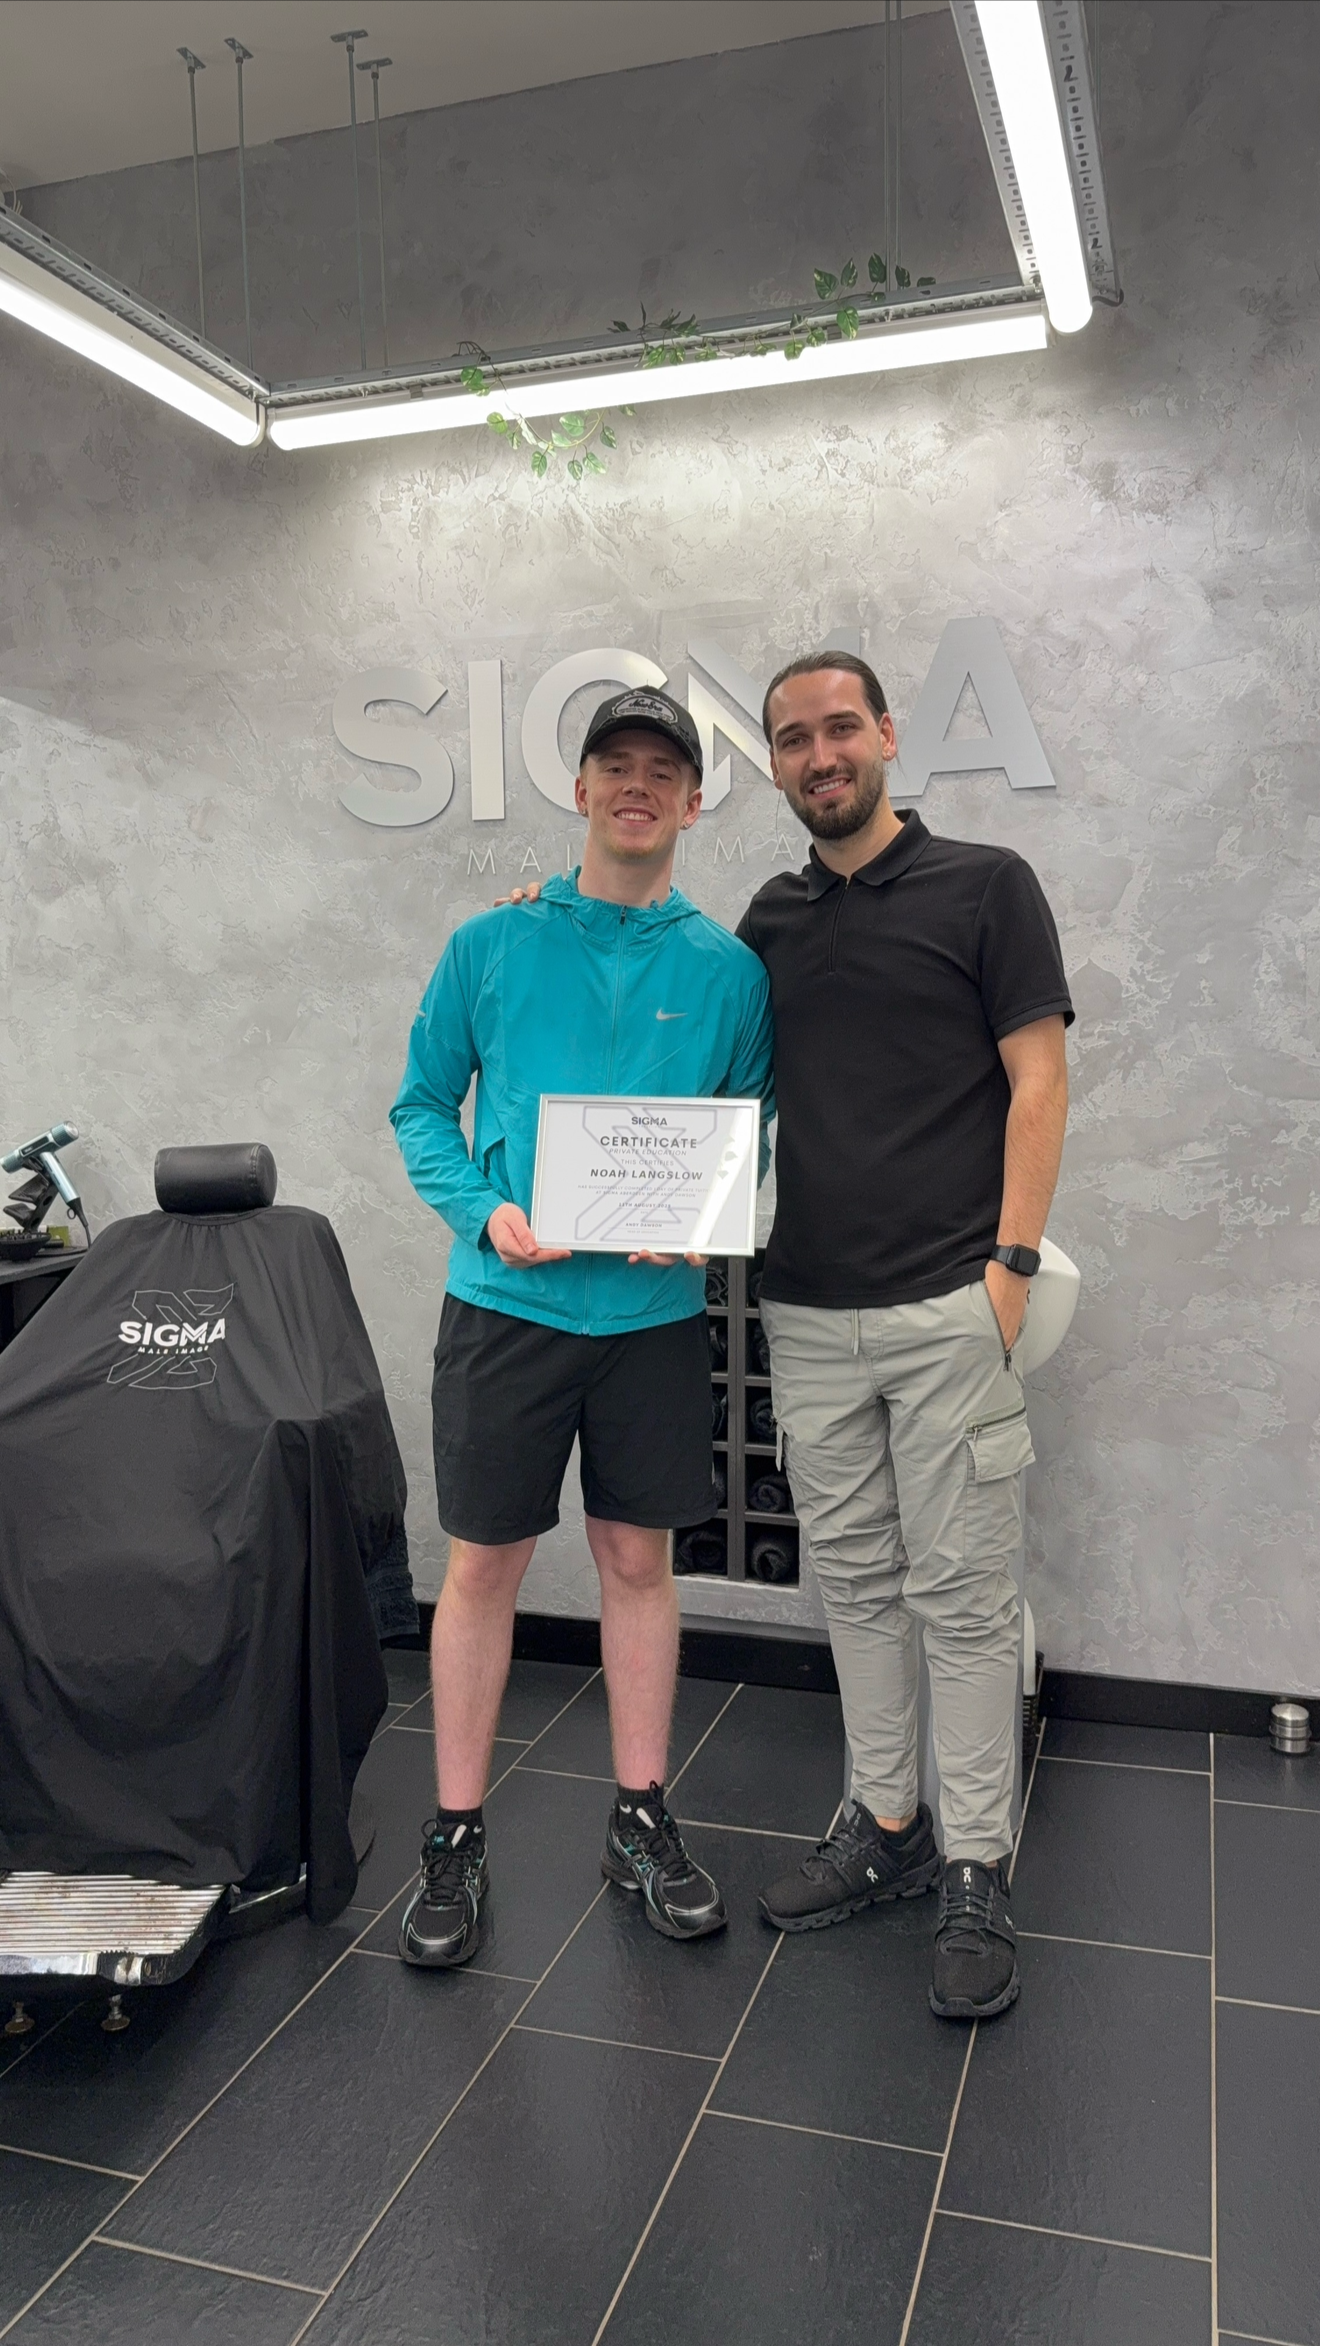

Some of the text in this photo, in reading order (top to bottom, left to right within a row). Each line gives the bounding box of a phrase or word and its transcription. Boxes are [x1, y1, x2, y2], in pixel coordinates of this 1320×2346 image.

[467, 837, 795, 876] MAL IMA
[631, 1116, 668, 1126] SIGMA
[600, 1136, 698, 1148] CERTIFICATE
[590, 1168, 703, 1180] NOAH LANGSLOW
[118, 1318, 226, 1347] SIGMA
[175, 1345, 209, 1354] IMAGE
